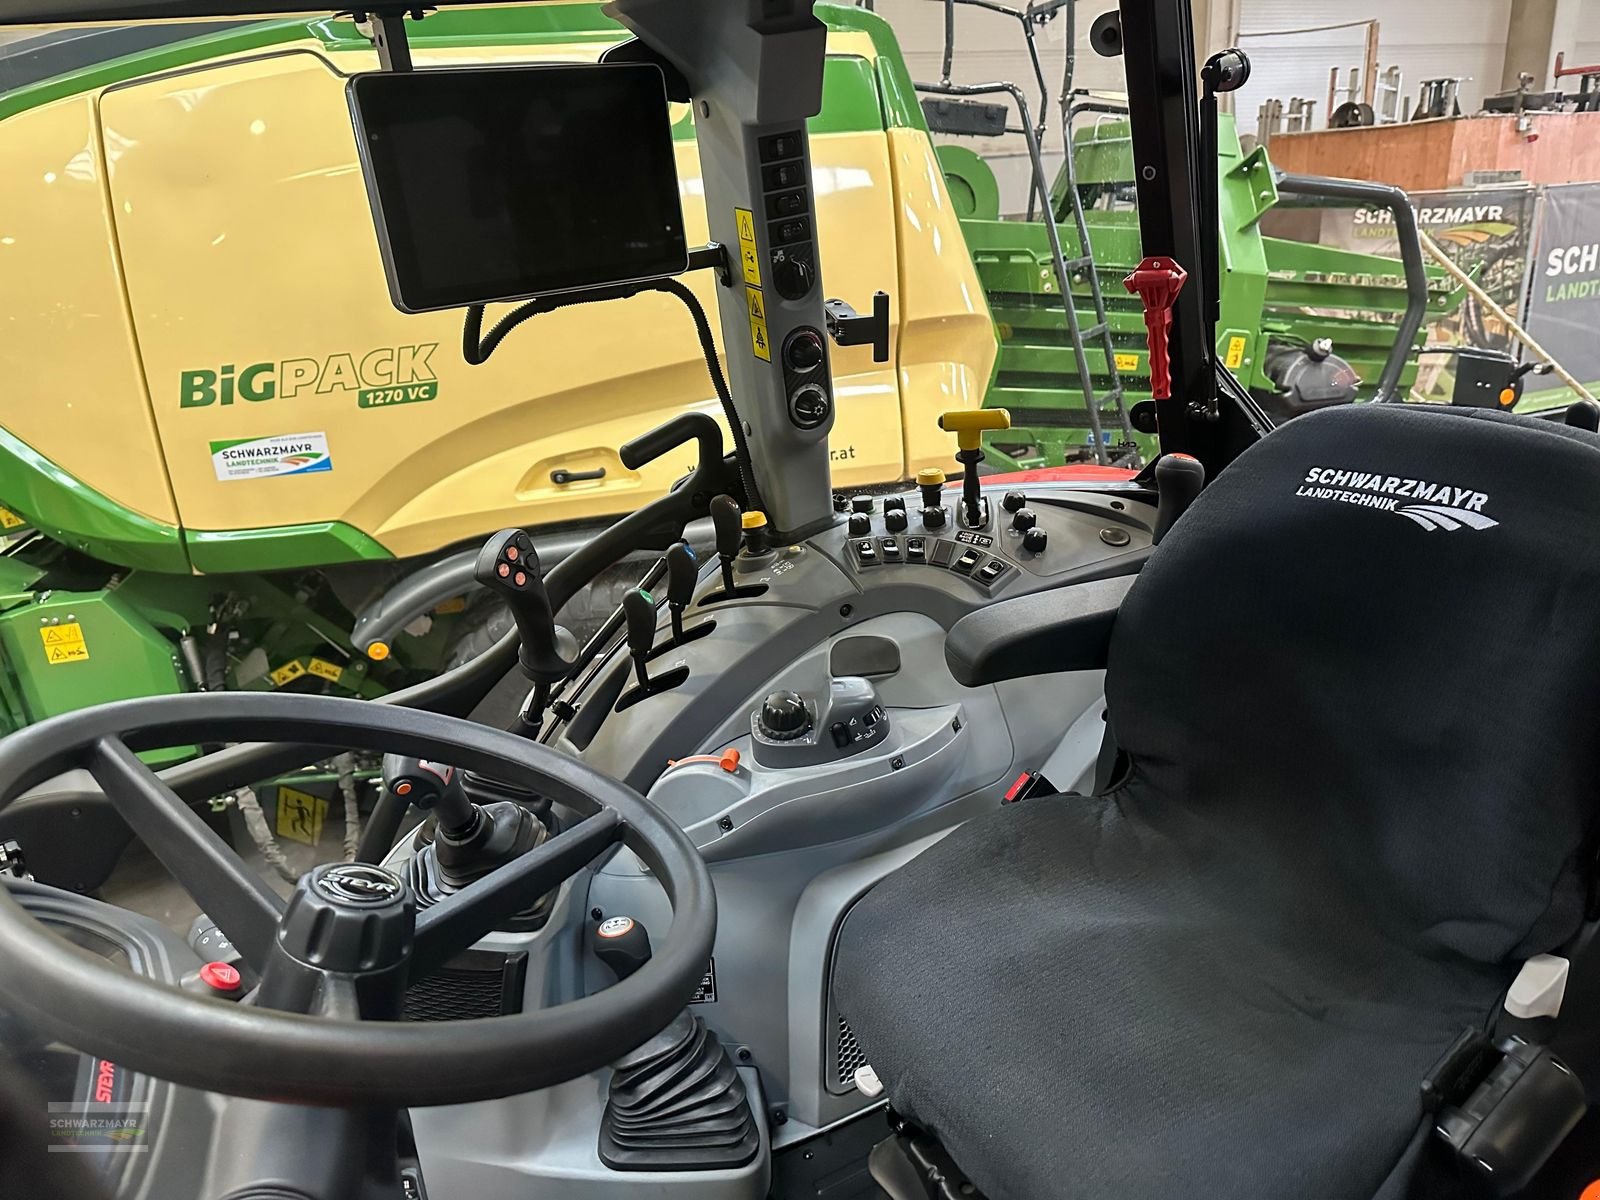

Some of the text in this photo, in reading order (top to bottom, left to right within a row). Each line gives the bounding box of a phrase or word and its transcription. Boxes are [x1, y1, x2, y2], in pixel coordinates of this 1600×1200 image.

[1353, 205, 1503, 224] SCHRZMAYR
[1545, 244, 1600, 276] SCH
[1546, 279, 1600, 302] LANDT
[366, 385, 430, 406] 1270 VC
[222, 443, 312, 459] SCHWARZMAYR
[226, 457, 279, 467] LANDTECHNIK
[1296, 485, 1399, 511] LANDTECHNIK
[1305, 467, 1488, 511] SCHWARZMAYR
[96, 1060, 114, 1104] STEYR
